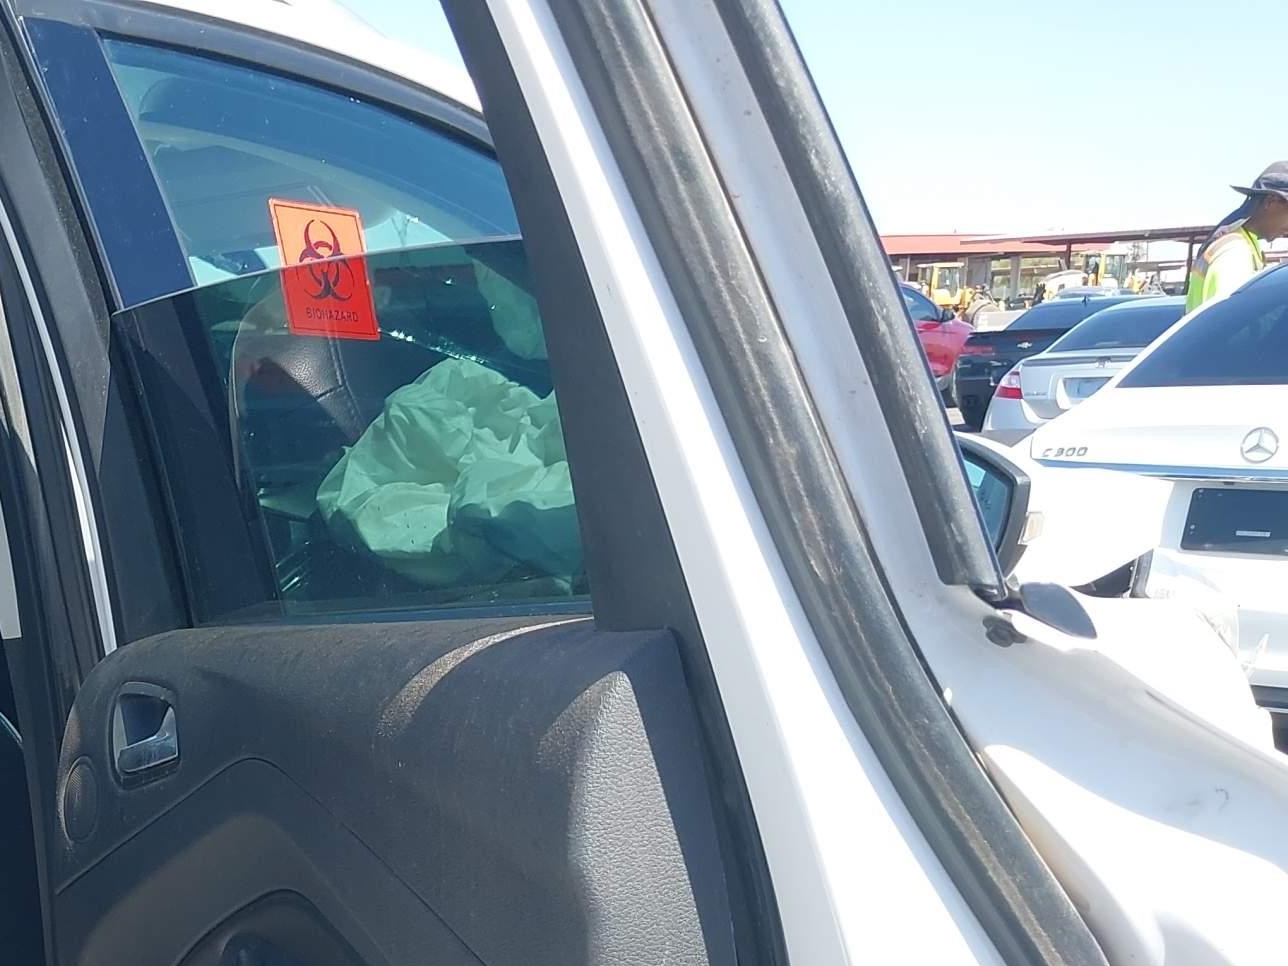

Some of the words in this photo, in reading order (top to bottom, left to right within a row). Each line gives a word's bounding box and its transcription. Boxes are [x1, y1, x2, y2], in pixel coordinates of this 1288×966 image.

[306, 307, 359, 323] BIOHAZARD
[1042, 447, 1053, 458] C
[1053, 446, 1089, 457] 300
